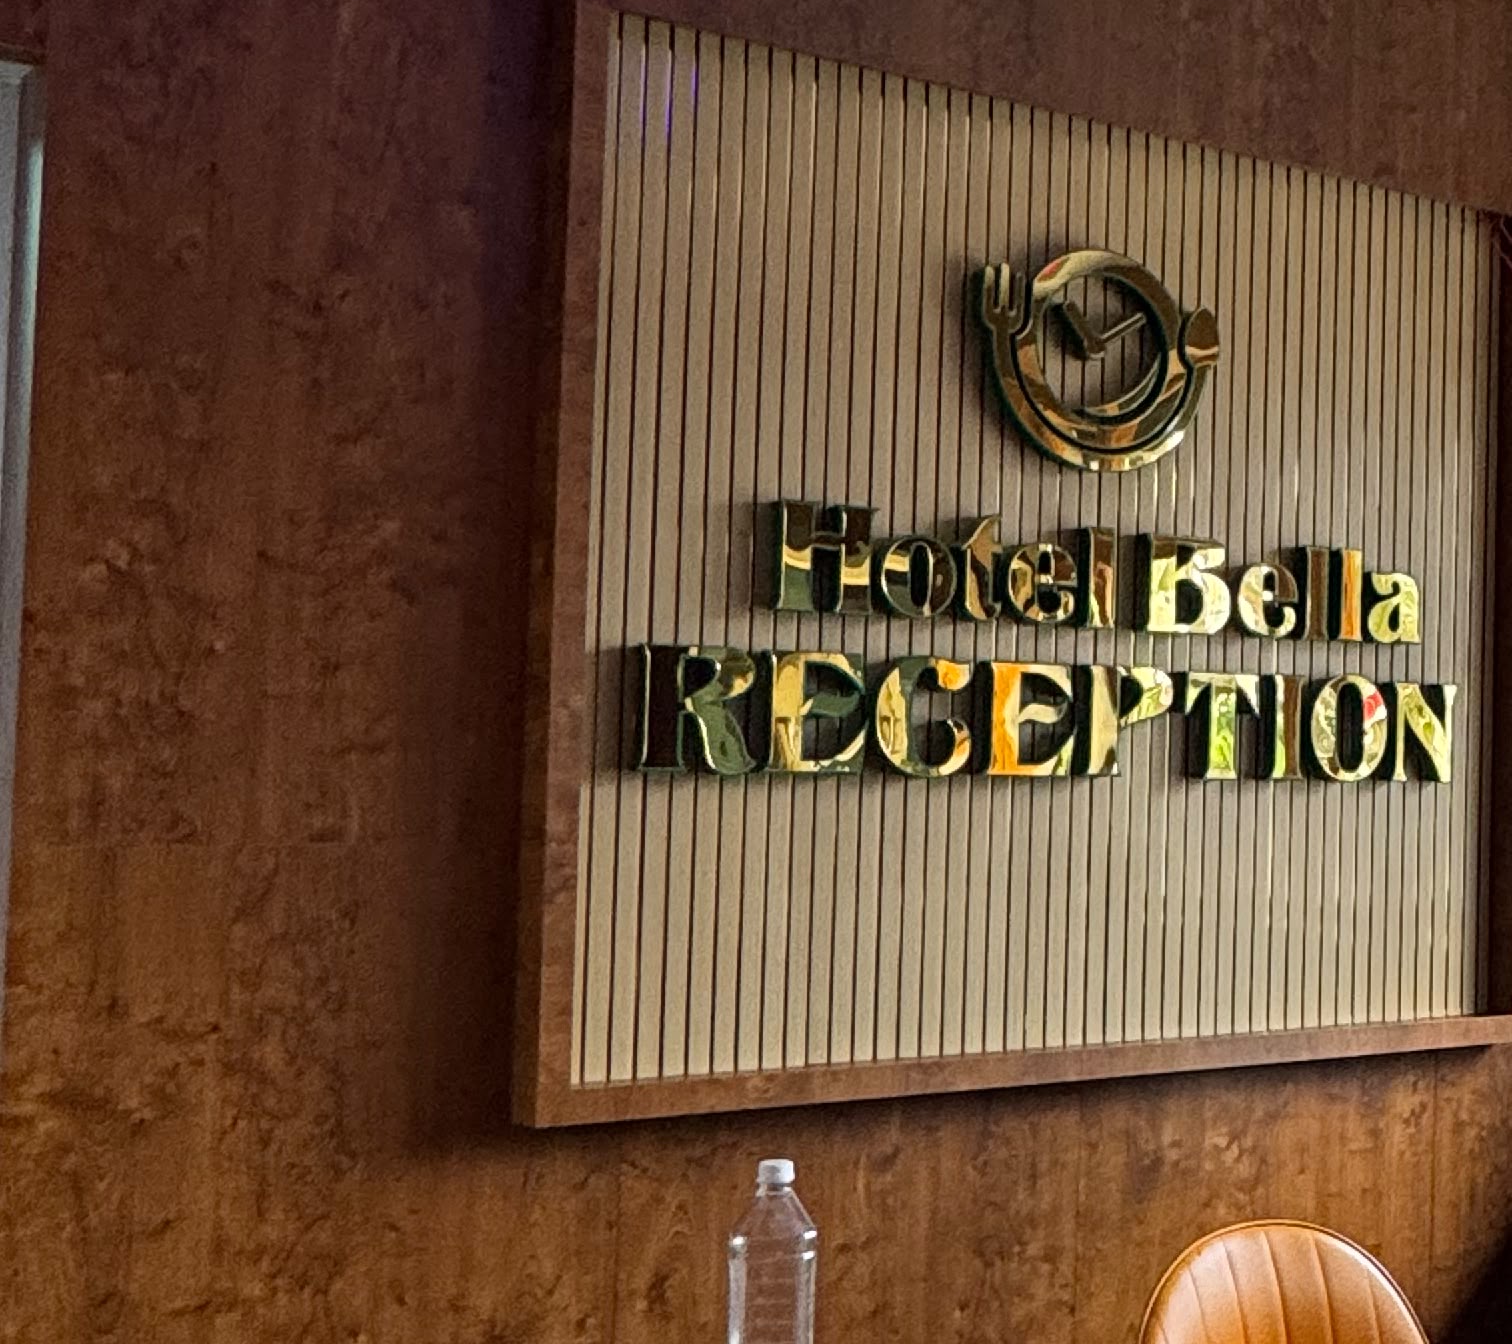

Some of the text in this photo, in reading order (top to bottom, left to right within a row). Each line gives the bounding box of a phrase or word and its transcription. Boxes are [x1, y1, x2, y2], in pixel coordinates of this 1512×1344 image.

[768, 498, 1420, 644] Hotel Bella
[636, 642, 1457, 783] RECEPTION
